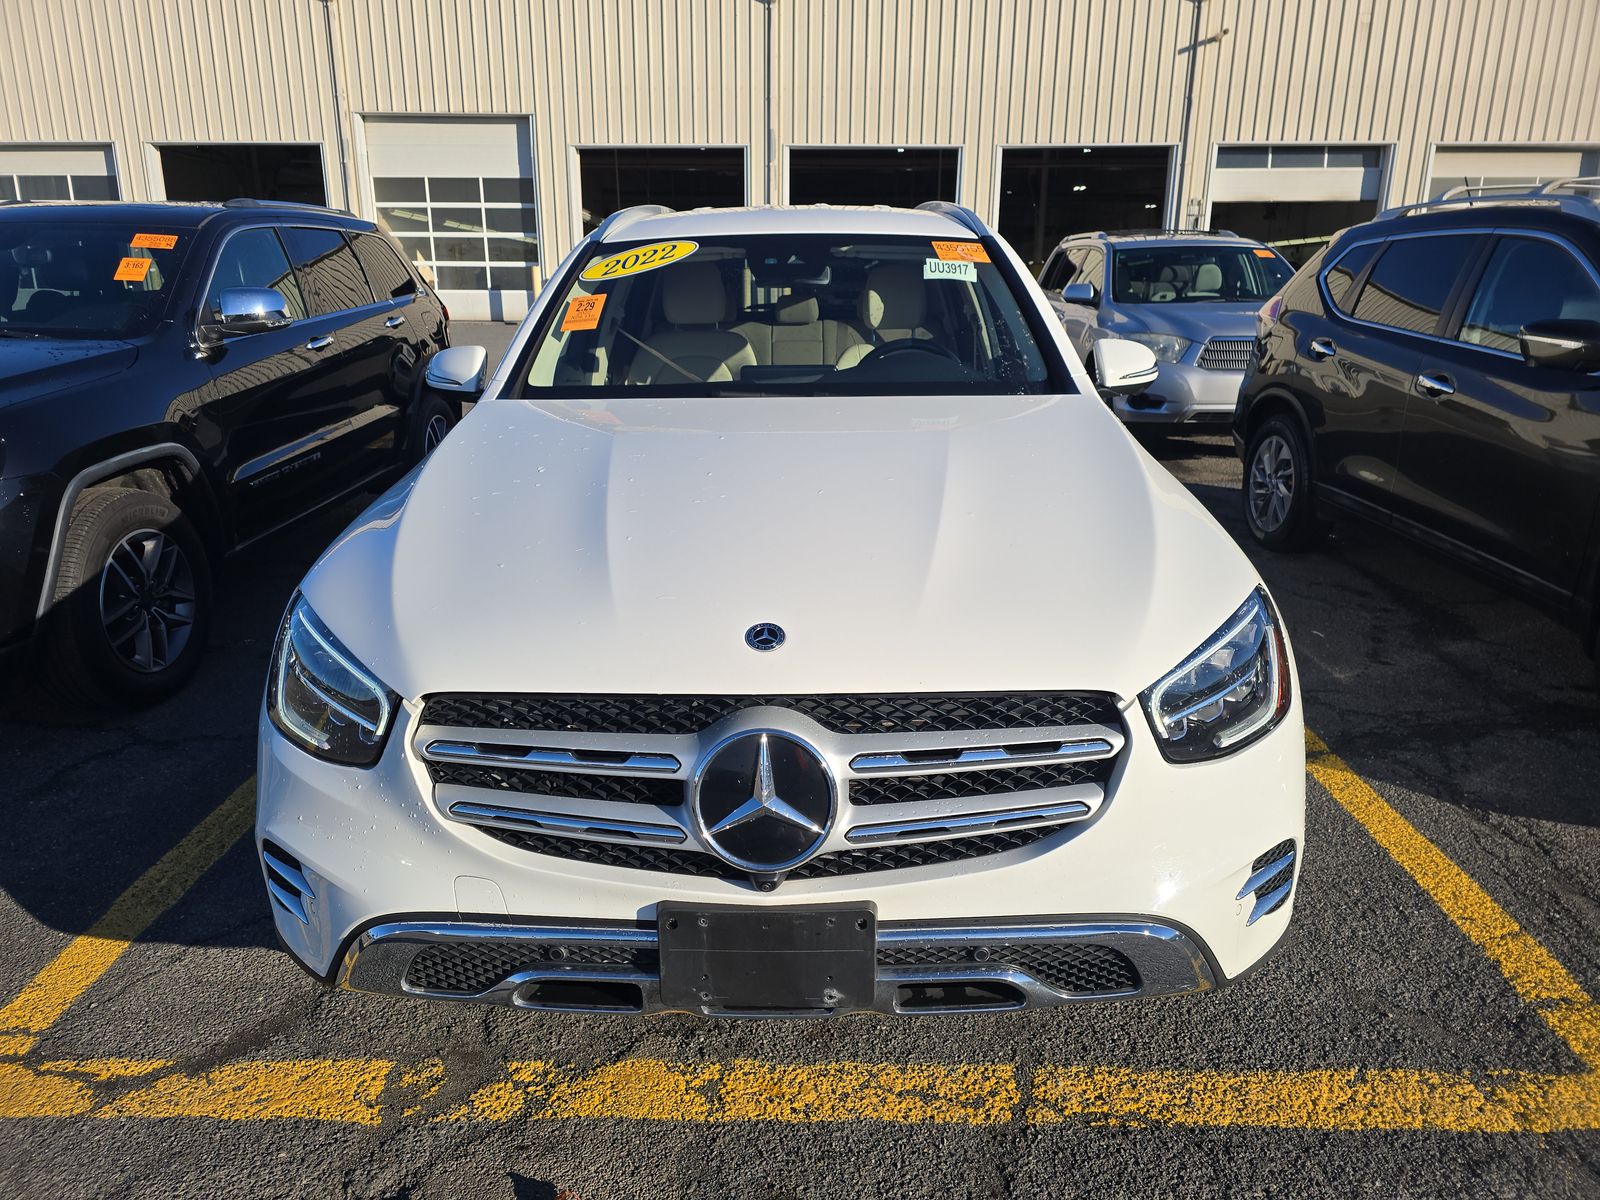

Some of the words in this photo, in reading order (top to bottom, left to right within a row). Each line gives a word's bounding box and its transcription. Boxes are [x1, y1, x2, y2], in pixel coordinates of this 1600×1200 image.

[601, 244, 677, 276] 2022
[929, 261, 969, 275] UU3917
[576, 301, 596, 312] 2:29
